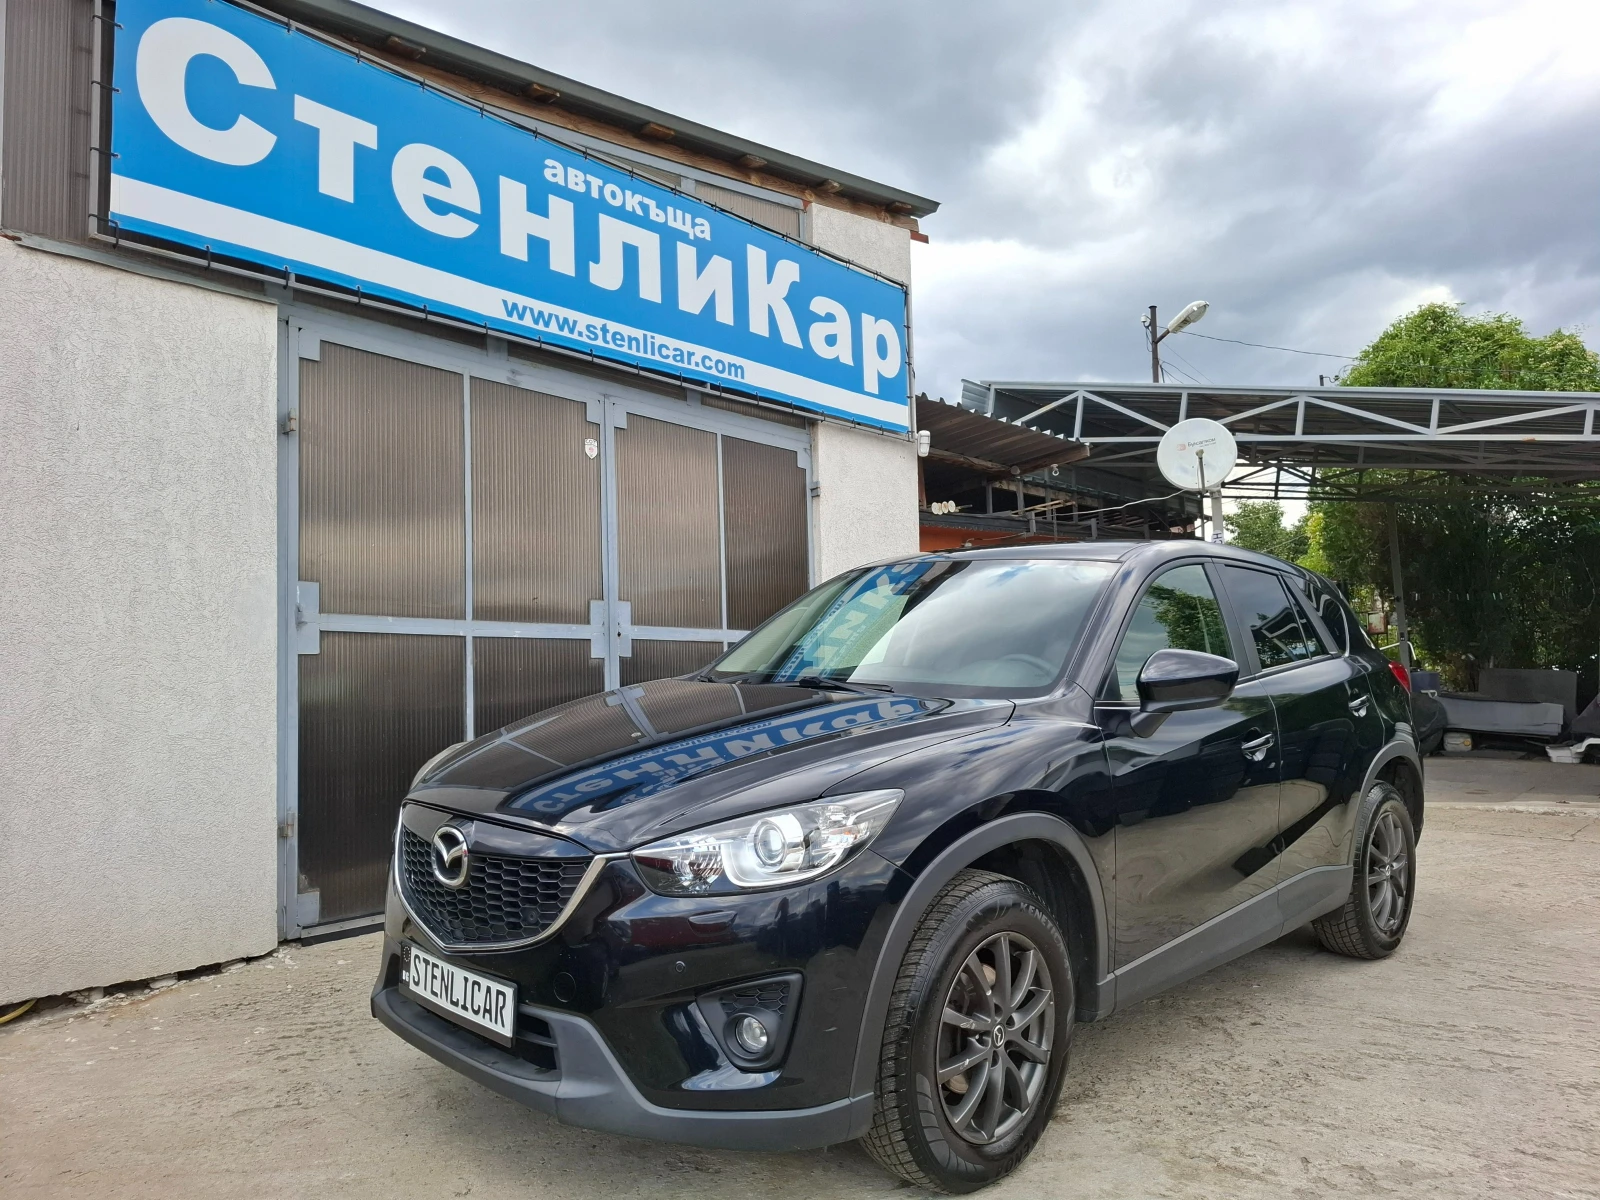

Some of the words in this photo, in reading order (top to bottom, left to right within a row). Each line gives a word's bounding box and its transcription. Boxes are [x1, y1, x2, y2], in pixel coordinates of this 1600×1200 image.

[136, 17, 901, 394] СтенлиКар
[543, 158, 711, 241] автокъща
[501, 298, 746, 380] www.stenlicar.com
[412, 953, 507, 1028] STENLICAR
